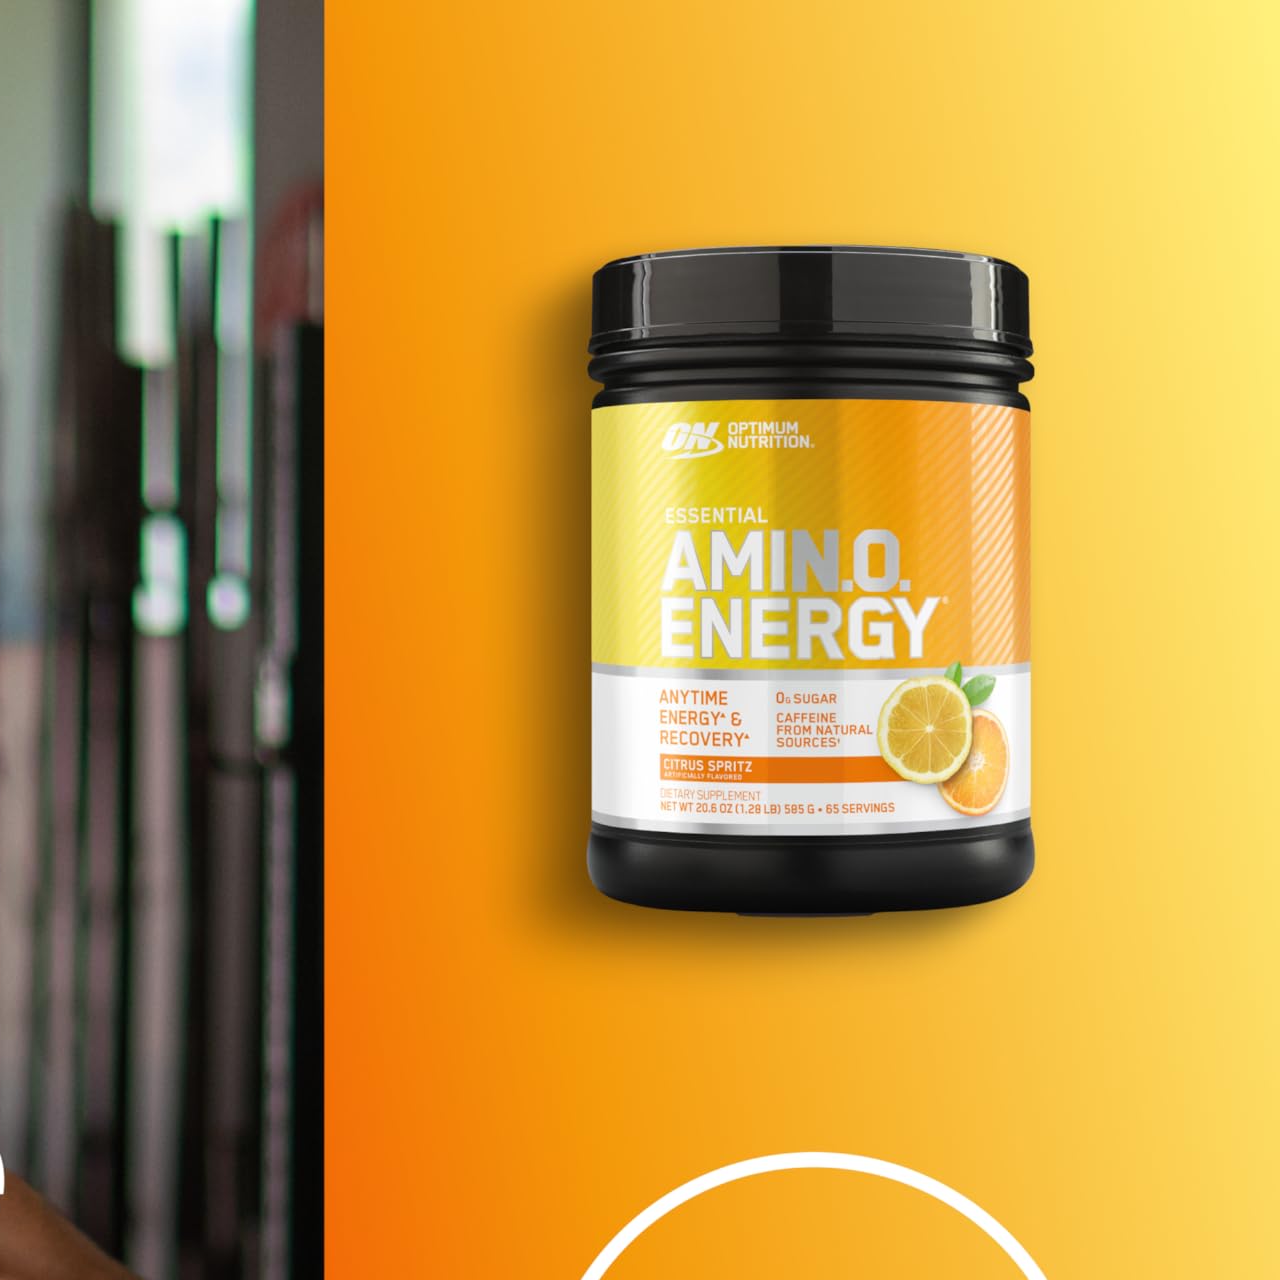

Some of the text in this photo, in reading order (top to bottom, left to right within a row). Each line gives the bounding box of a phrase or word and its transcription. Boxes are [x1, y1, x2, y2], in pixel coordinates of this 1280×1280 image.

[728, 421, 799, 435] OPTIMUM
[665, 507, 768, 524] ESSENTIAL
[661, 529, 911, 593] AMIN.O.
[660, 596, 941, 661] ENERGY
[659, 689, 728, 705] ANYTIME
[793, 693, 837, 704] SUGAR
[776, 712, 837, 723] CAFFEINE
[776, 724, 873, 735] FROM NATURAL
[663, 758, 753, 773] CITRUS SPRITZ
[696, 789, 761, 801] SUPPLEMENT
[660, 802, 677, 811] NET
[679, 802, 693, 812] WT
[696, 802, 717, 813] 20.6
[720, 804, 733, 813] OZ
[784, 804, 805, 815] 585
[826, 804, 840, 814] 65
[842, 802, 895, 814] SERVINGS
